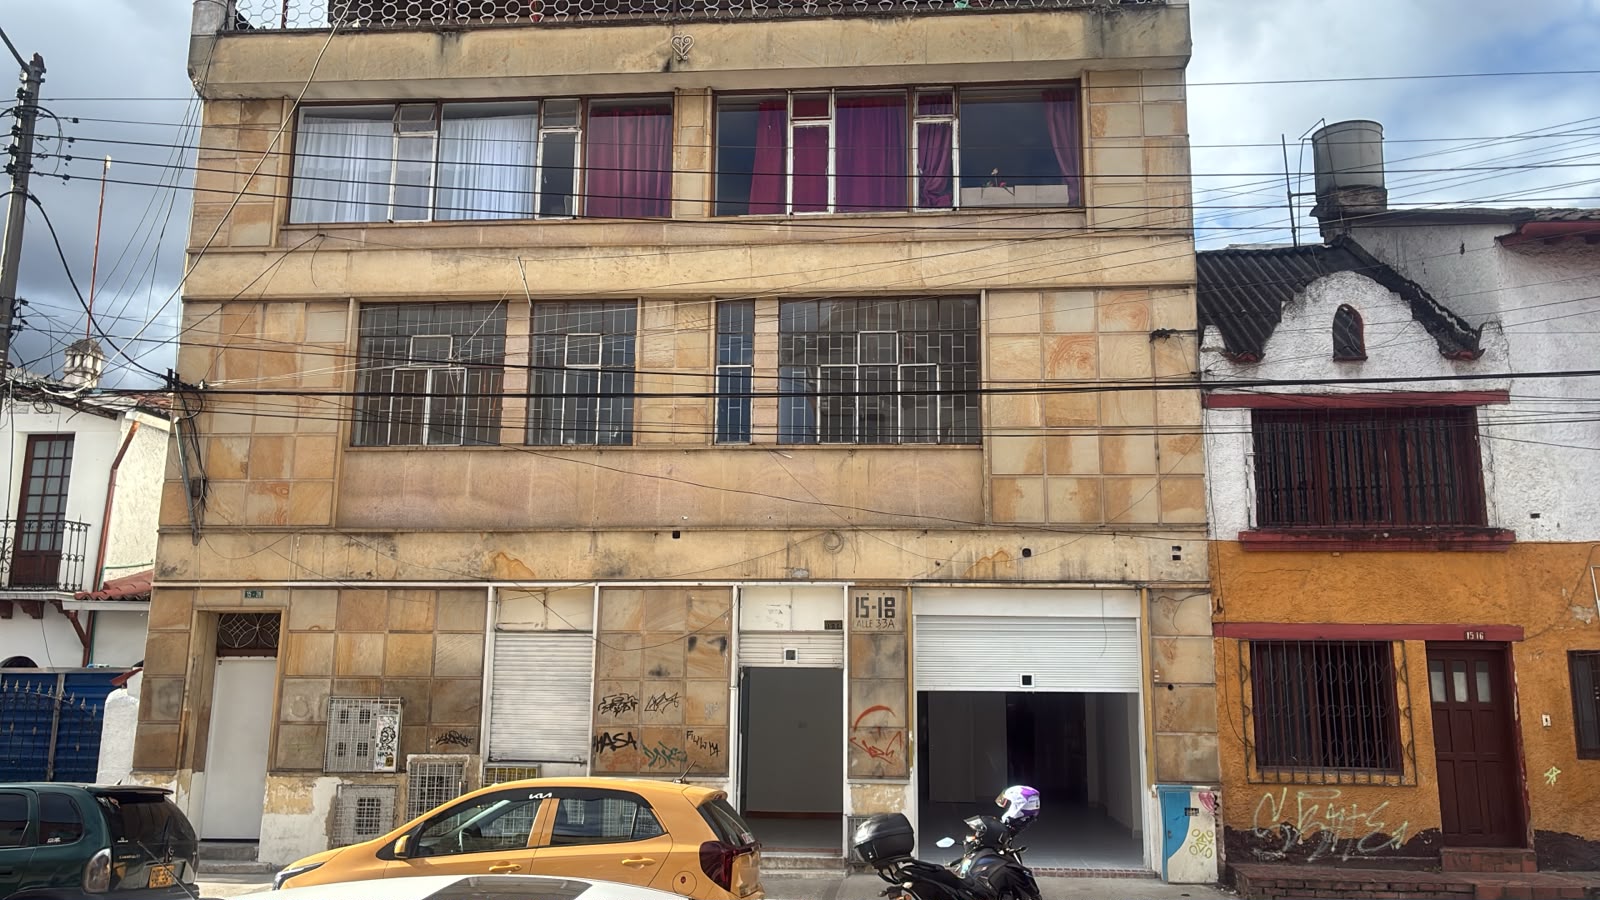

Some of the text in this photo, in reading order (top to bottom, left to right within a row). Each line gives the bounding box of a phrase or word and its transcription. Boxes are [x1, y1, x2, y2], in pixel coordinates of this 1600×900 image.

[855, 597, 895, 618] 15-18
[853, 619, 873, 629] ALLE
[875, 619, 895, 629] 33A
